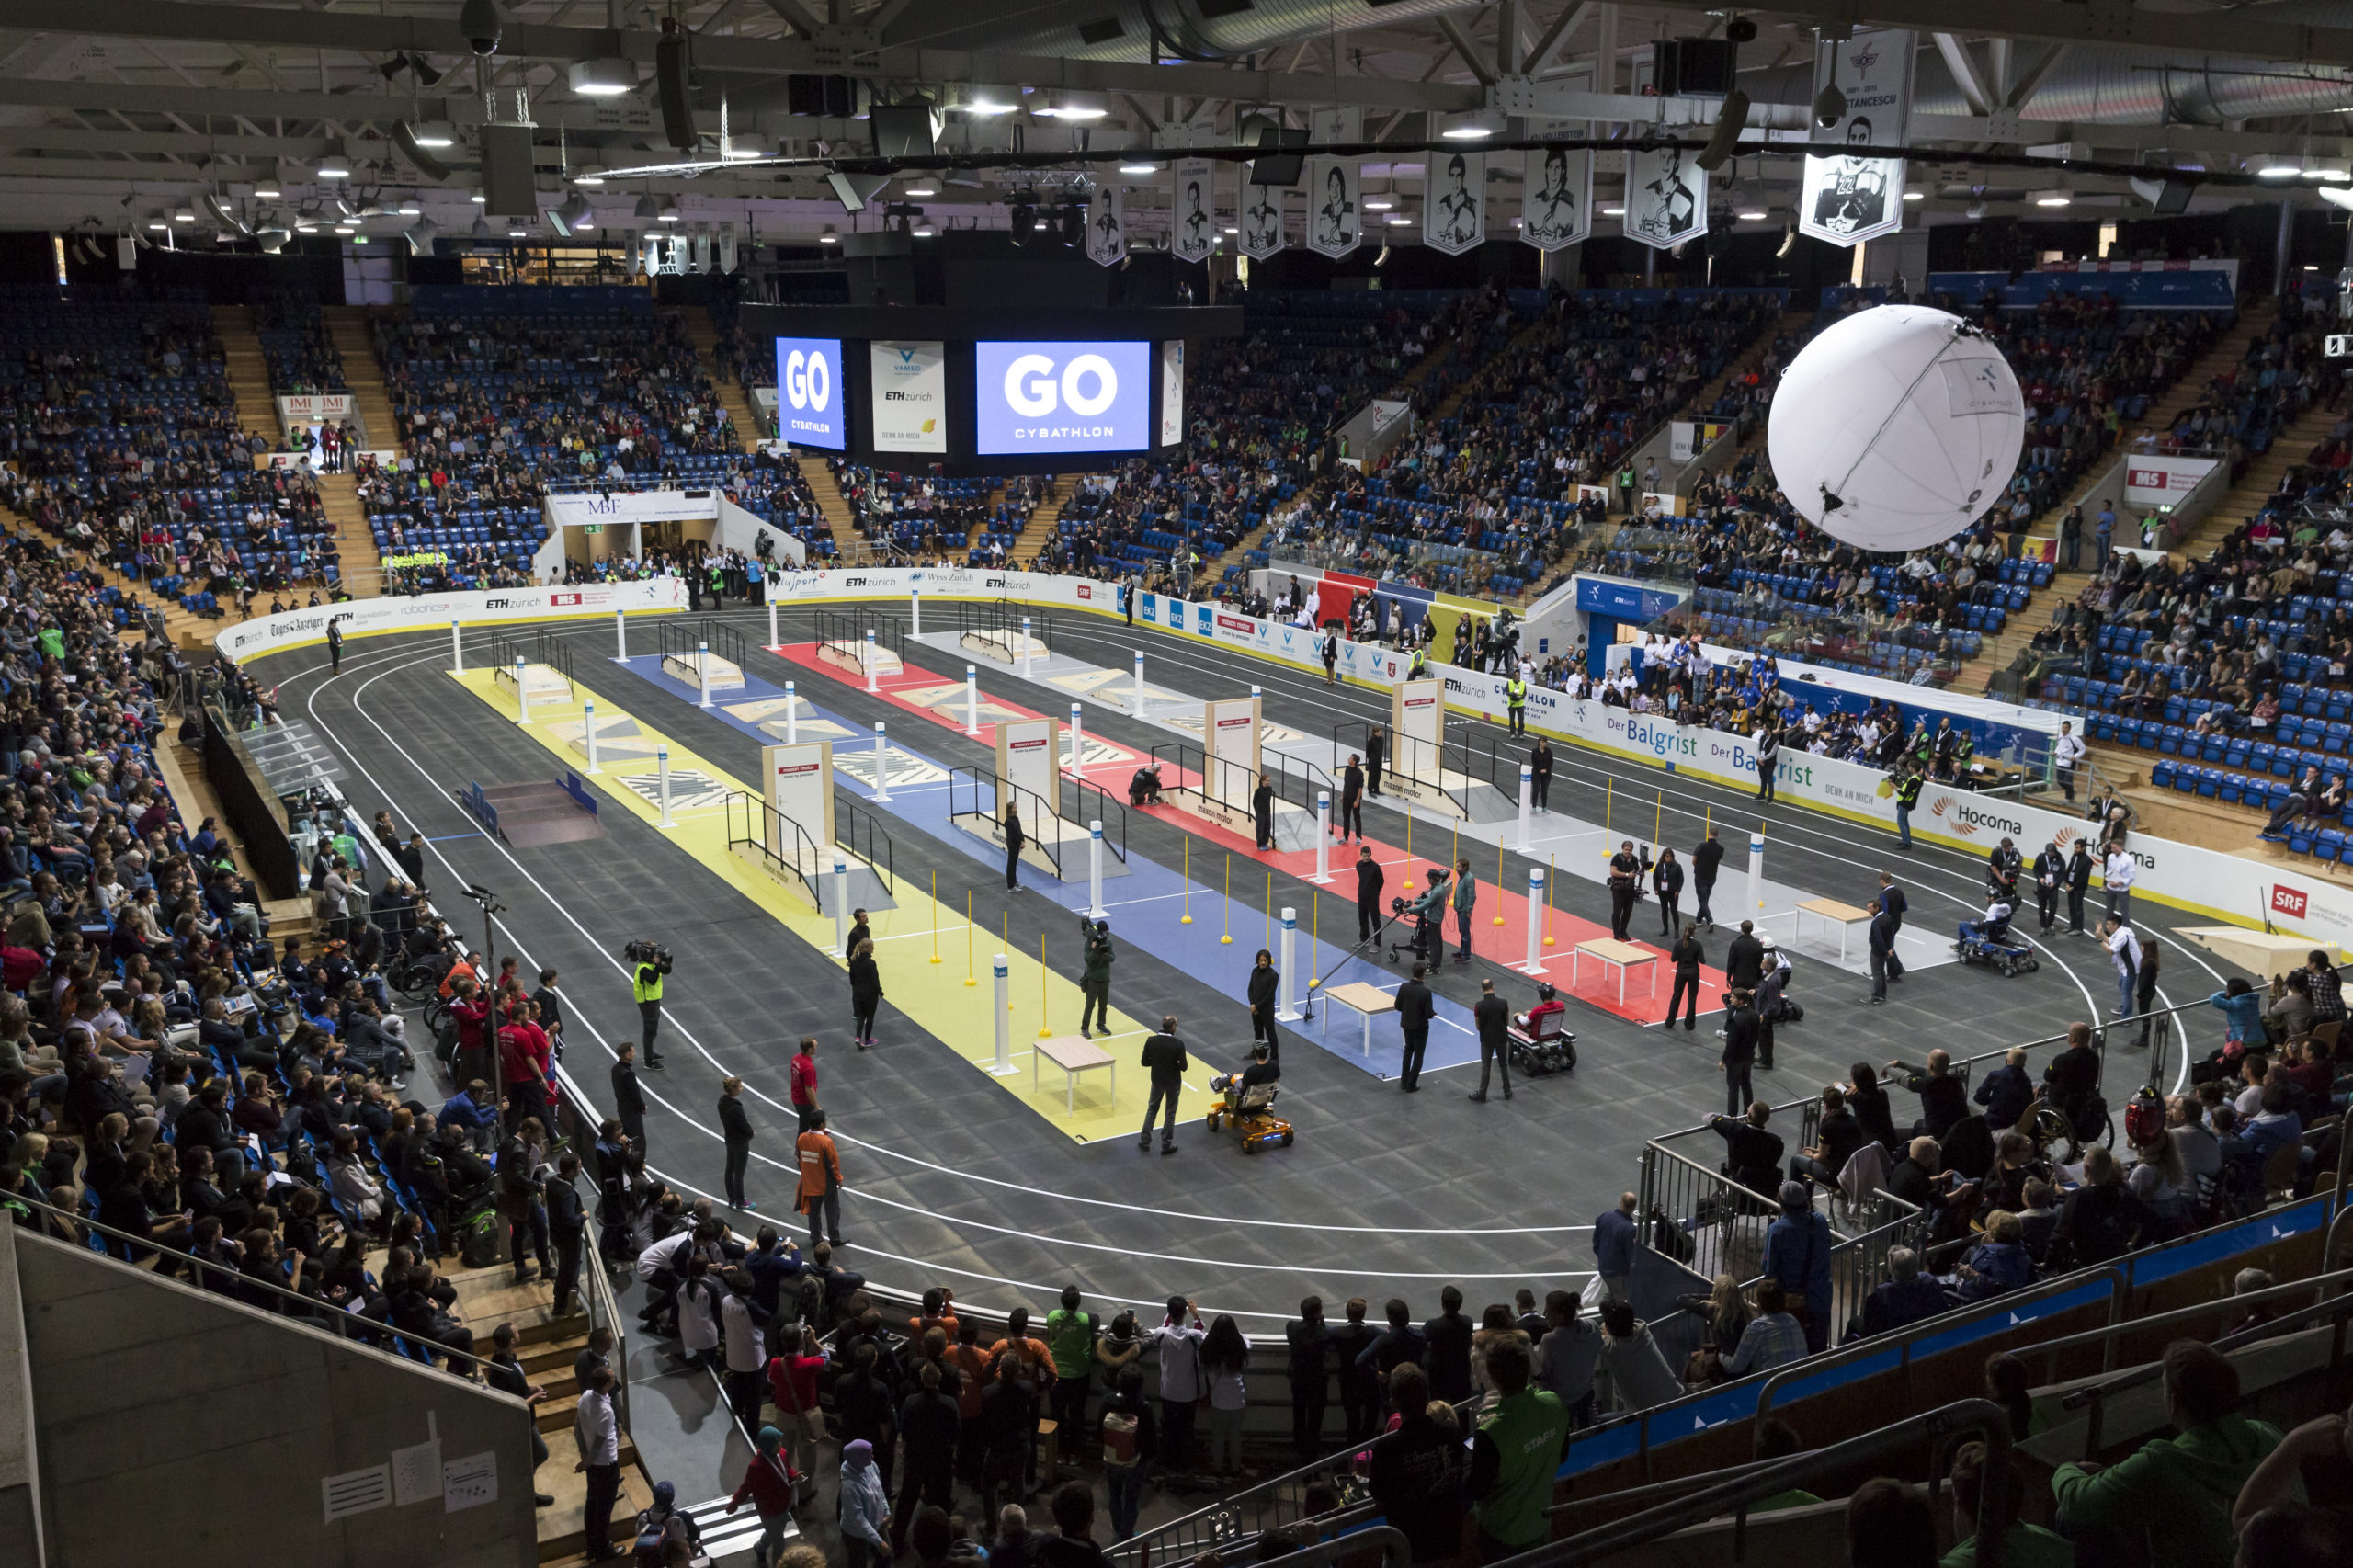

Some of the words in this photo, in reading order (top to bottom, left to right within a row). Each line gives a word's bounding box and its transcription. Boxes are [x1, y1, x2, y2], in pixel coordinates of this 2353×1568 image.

[1836, 176, 1856, 196] 22
[786, 349, 830, 412] GO
[1004, 354, 1118, 417] GO
[885, 391, 904, 402] ETH
[904, 391, 933, 402] zürich
[791, 419, 830, 434] CYBATHLON
[1015, 426, 1114, 439] CYBATHLON
[881, 431, 896, 440] DENK
[905, 432, 920, 440] MICH
[2135, 472, 2160, 486] MS
[846, 578, 867, 587] ETH
[867, 576, 896, 587] zürich
[927, 573, 948, 583] Wyss
[986, 578, 1006, 588] ETH
[1006, 579, 1031, 591] zürich
[1079, 587, 1090, 597] SRF
[486, 598, 509, 609] ETH
[510, 597, 541, 608] zürich
[557, 595, 575, 605] MS
[1118, 598, 1127, 608] EK
[401, 603, 446, 615] robotics
[1143, 606, 1155, 617] EKZ
[335, 612, 354, 622] ETH
[1171, 612, 1183, 624] EKZ
[270, 622, 290, 637] Tages
[295, 617, 324, 633] Anzeiger
[1199, 619, 1211, 631] EKZ
[1222, 618, 1236, 628] maxon
[1237, 622, 1251, 631] motor
[235, 635, 246, 648] ETH
[1280, 645, 1295, 654] VAMED
[1341, 661, 1357, 670] VAMED
[1370, 668, 1385, 677] VAMED
[1445, 677, 1461, 692] ETH
[1461, 684, 1486, 699] zürich
[1494, 684, 1556, 708] CYHLON
[1608, 718, 1625, 732] Der
[1627, 719, 1698, 757] Balgrist
[1711, 744, 1731, 758] Der
[1733, 745, 1813, 787] Barist
[1383, 780, 1404, 792] maxon
[1404, 787, 1422, 799] motor
[1824, 783, 1844, 797] DENK
[1844, 789, 1854, 800] AN
[1855, 791, 1873, 805] MICH
[1198, 804, 1216, 818] maxon
[1216, 812, 1233, 824] motor
[1958, 804, 2022, 835] Hocoma
[2085, 836, 2155, 869] Homa
[2275, 891, 2304, 911] SRF
[1523, 1428, 1556, 1454] STAFF
